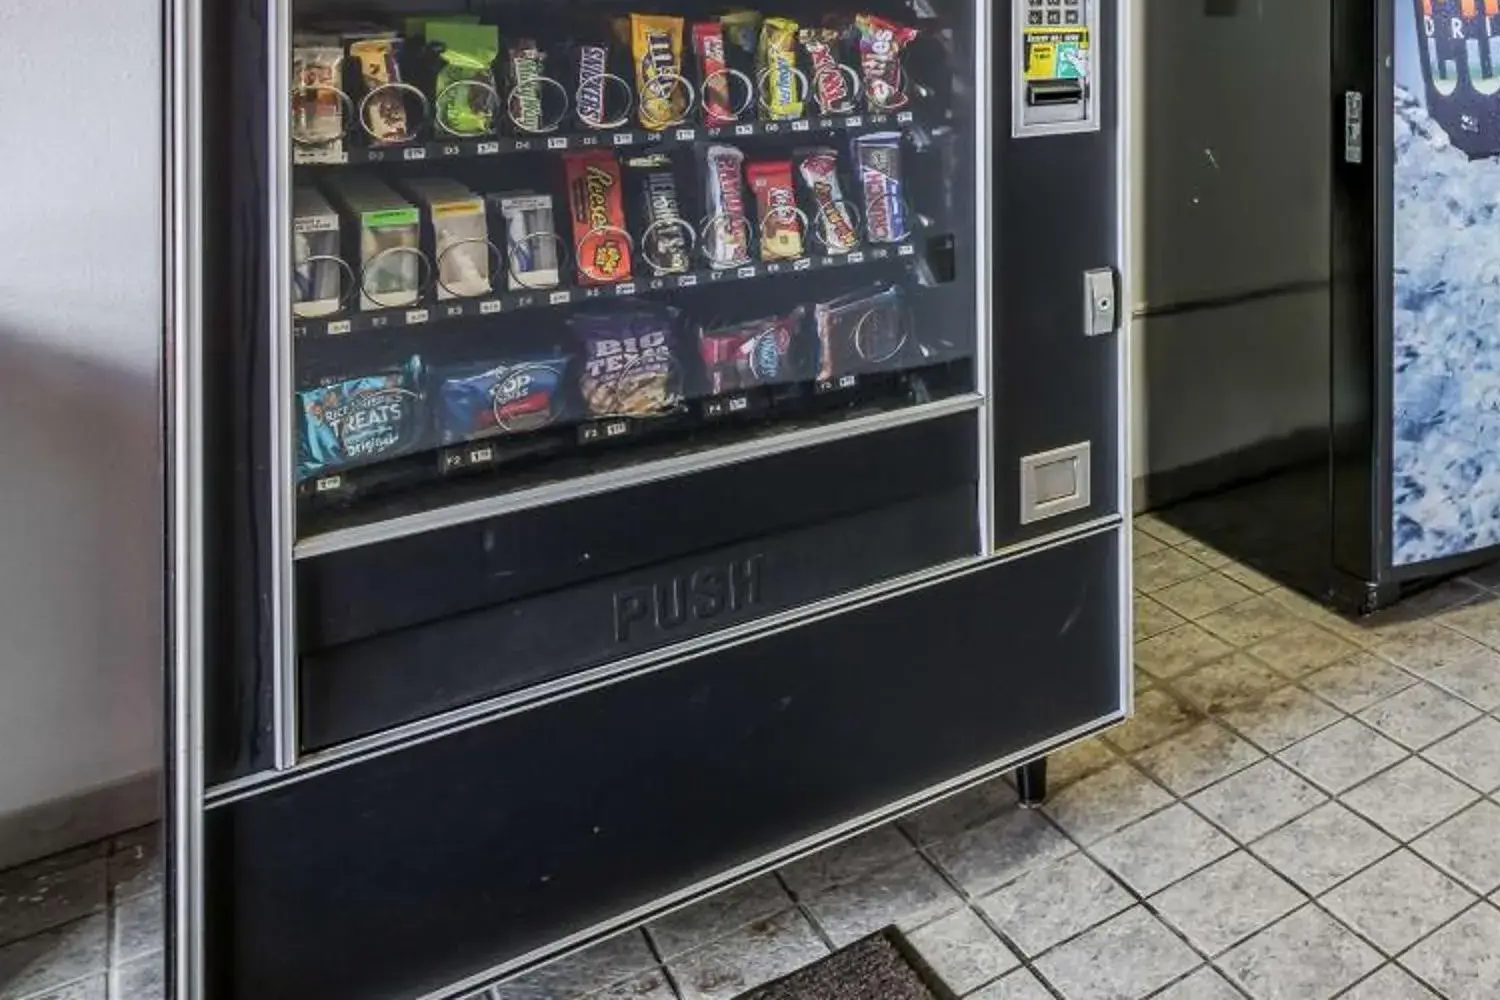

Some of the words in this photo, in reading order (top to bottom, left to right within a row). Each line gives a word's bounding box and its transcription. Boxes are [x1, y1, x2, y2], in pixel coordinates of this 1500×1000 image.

[595, 331, 665, 357] BIG
[329, 403, 402, 438] TREATS
[612, 552, 764, 642] PUSH
